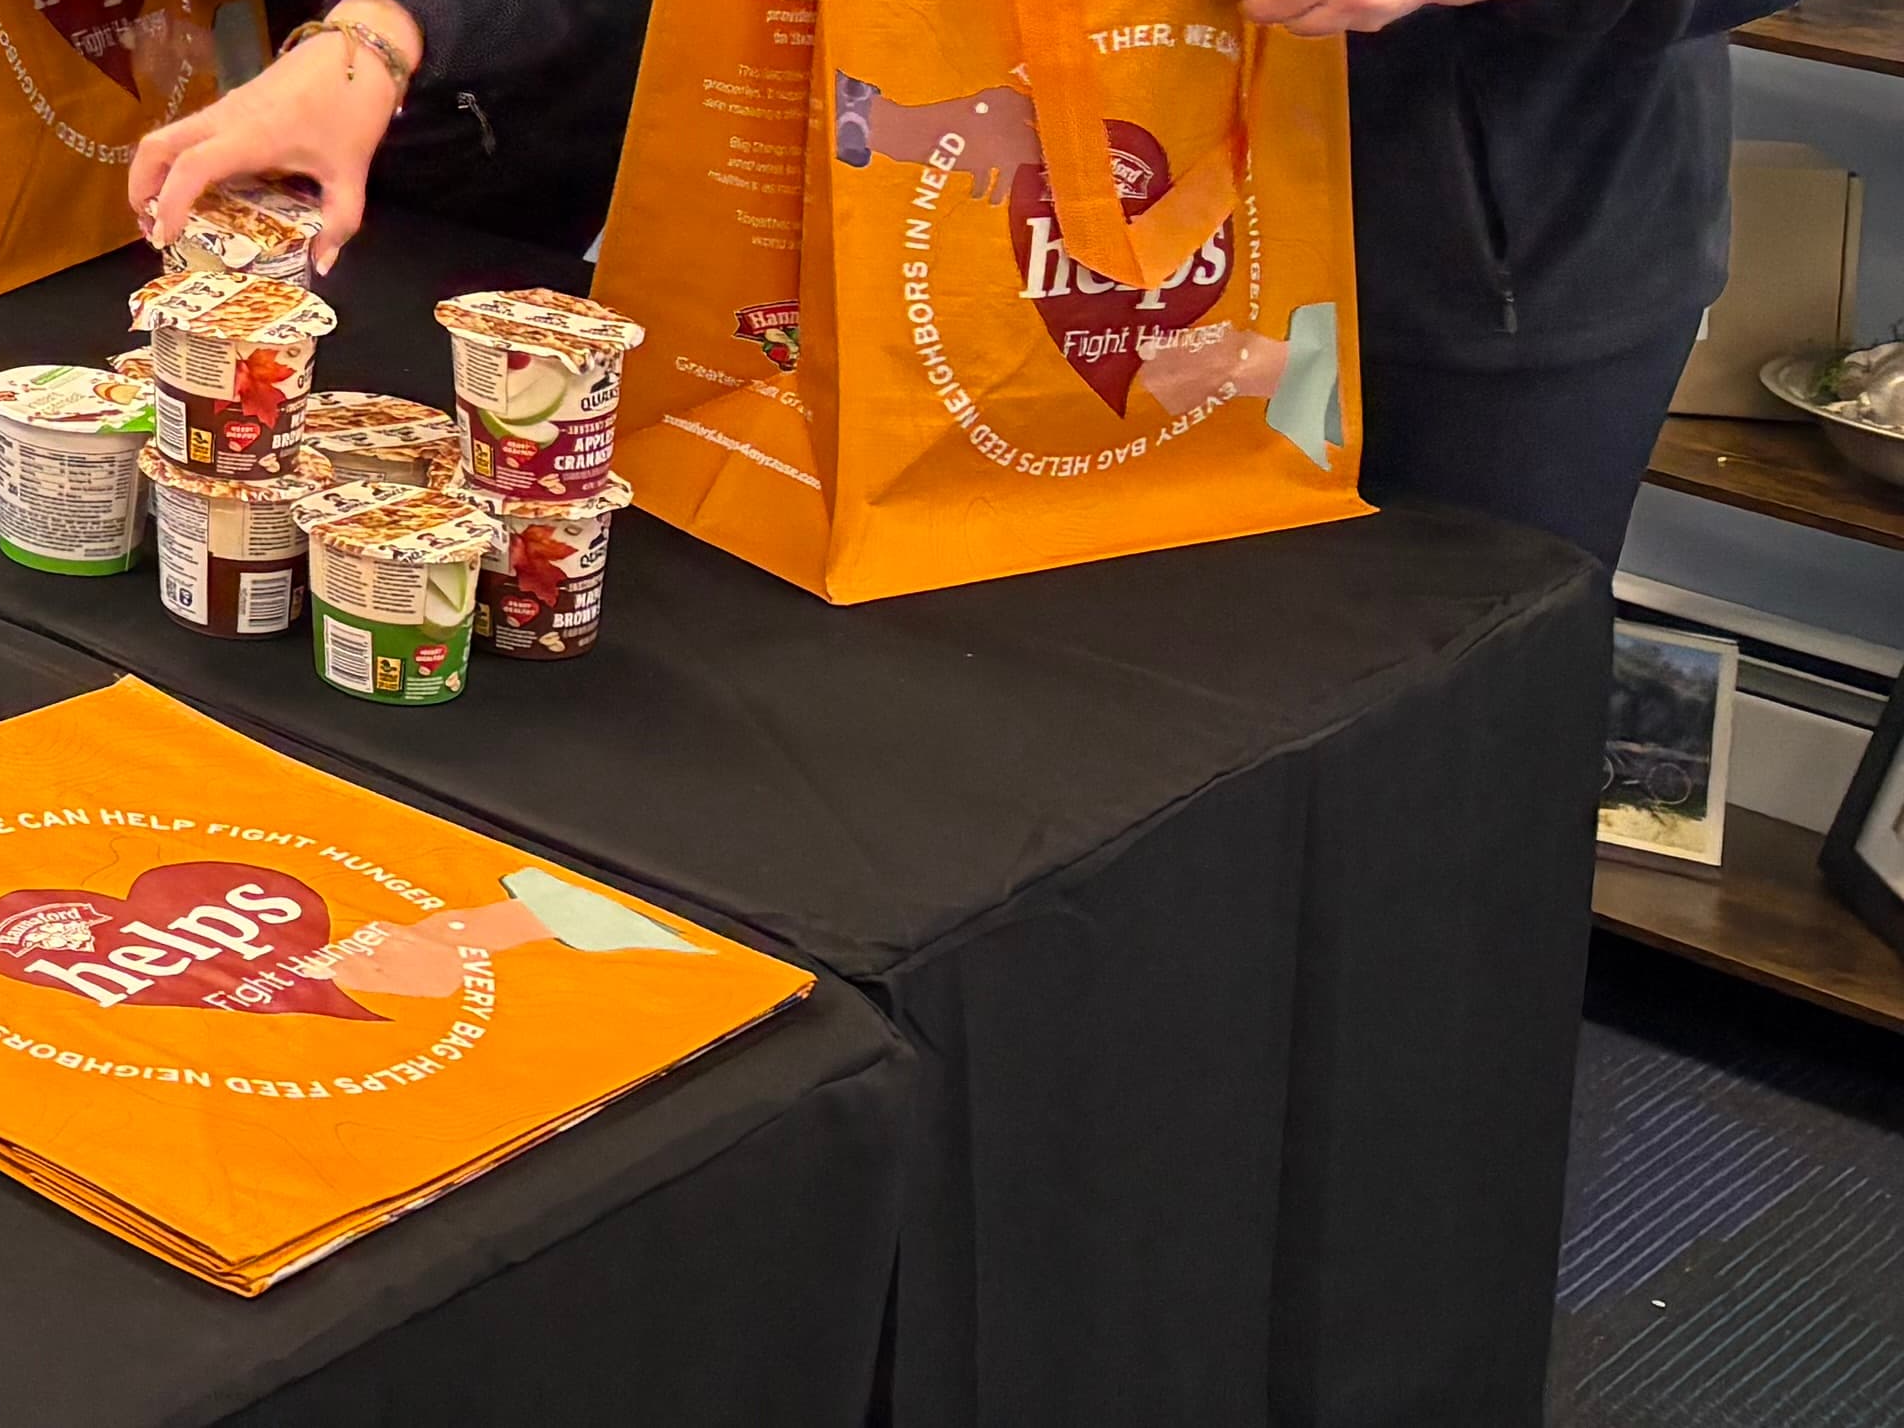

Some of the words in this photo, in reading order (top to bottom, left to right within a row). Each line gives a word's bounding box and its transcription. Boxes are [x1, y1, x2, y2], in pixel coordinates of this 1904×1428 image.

[1089, 23, 1175, 55] THER,
[56, 120, 94, 159] FEED
[911, 132, 967, 212] NEED
[902, 217, 933, 251] IN
[748, 310, 800, 330] Hann
[1063, 328, 1130, 363] Fight
[1135, 319, 1232, 361] Hunger
[901, 259, 981, 431] NEIGHBORS
[1156, 380, 1239, 448] EVERY
[968, 422, 1019, 467] FEED
[1015, 452, 1092, 479] HELPS
[1096, 436, 1148, 472] BAG
[17, 807, 91, 831] CAN
[99, 808, 197, 832] HELP
[206, 822, 318, 850] FIGHT
[319, 845, 446, 913] HUNGER
[23, 882, 303, 1009] helps
[201, 971, 295, 1013] Fight
[276, 920, 392, 980] Hunger
[456, 945, 496, 1021] EVERY
[430, 1020, 488, 1063] BAG
[223, 1075, 333, 1100] FEED
[332, 1054, 446, 1096] HELPS
